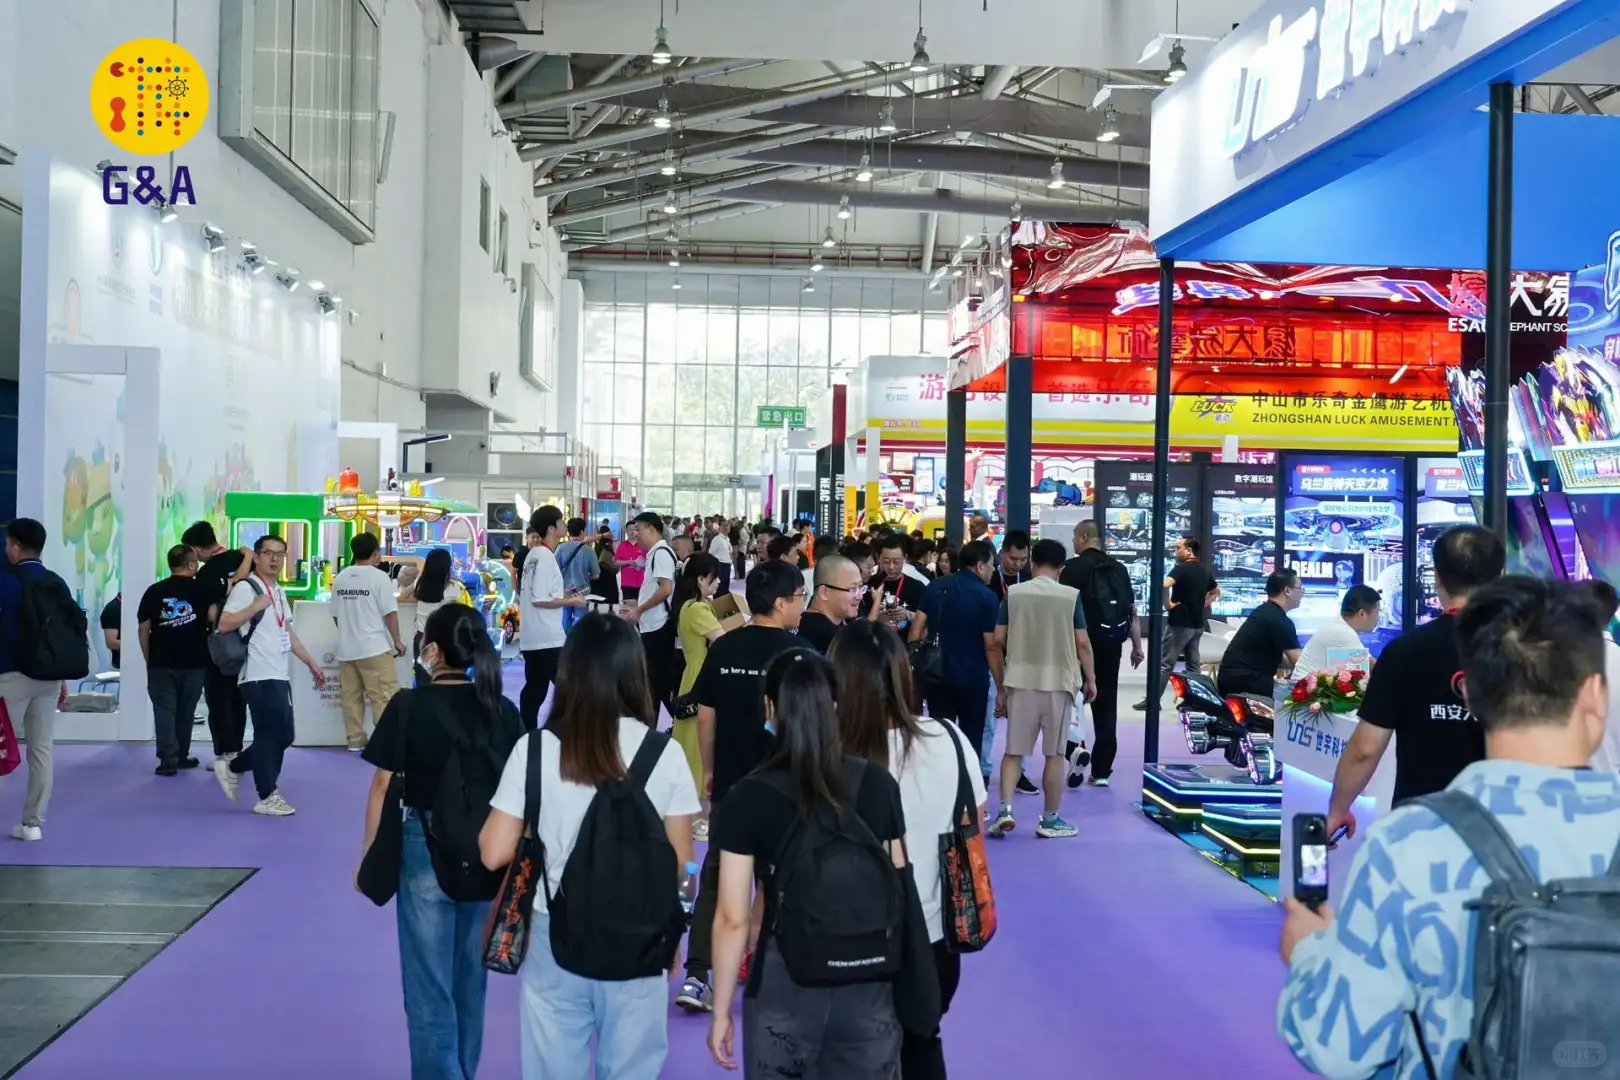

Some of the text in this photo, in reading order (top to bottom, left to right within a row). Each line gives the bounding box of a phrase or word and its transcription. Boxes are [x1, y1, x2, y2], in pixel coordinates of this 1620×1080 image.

[1510, 322, 1552, 332] EPHANT
[1252, 389, 1454, 411] 中山市乐奇金鹰游艺机
[1190, 400, 1237, 413] LUCK
[1253, 413, 1449, 427] ZHONGSHAN LUCK AMUSEMENT
[1234, 474, 1274, 484] 数字潮玩馆
[731, 666, 746, 674] hero
